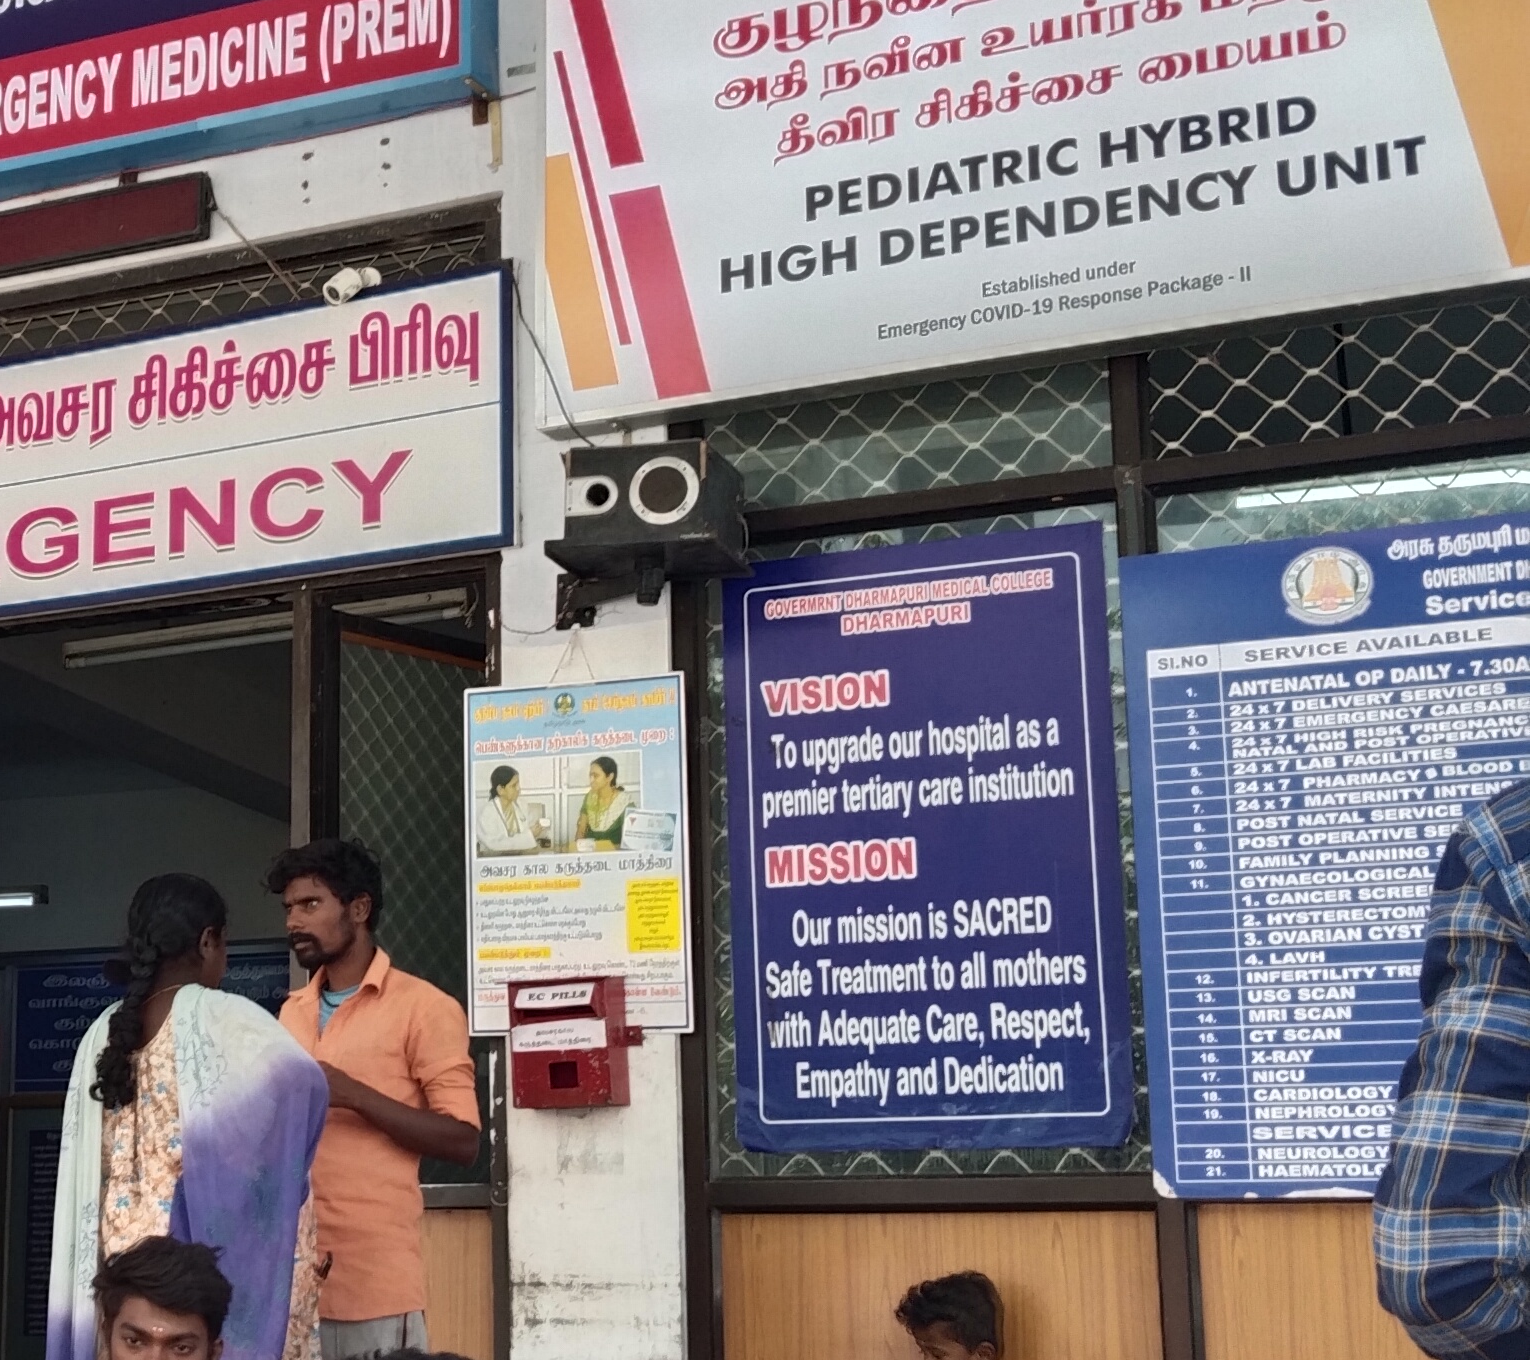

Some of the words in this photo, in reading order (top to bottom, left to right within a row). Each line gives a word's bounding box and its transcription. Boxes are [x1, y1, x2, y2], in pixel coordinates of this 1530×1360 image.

[131, 12, 306, 107] MEDICINE
[715, 59, 807, 109] அதி
[823, 35, 965, 96] நவீன
[774, 106, 899, 165] தீவிர
[915, 64, 1122, 127] சிகிச்சை
[1138, 12, 1345, 83] மையம்
[806, 137, 1077, 221] PEDIATRIC
[1099, 96, 1315, 168] HYBRID
[721, 236, 856, 292] HIGH
[879, 164, 1255, 265] DEPENDENCY
[1276, 135, 1425, 196] UNIT
[982, 267, 1079, 297] Established
[1085, 261, 1136, 280] under
[878, 314, 966, 339] Emergency
[970, 297, 1053, 324] COVID-19
[1058, 286, 1142, 311] Response
[1147, 273, 1223, 296] Package
[128, 339, 335, 424] சிகிச்சை
[349, 304, 478, 390] பிரிவு
[1423, 564, 1513, 589] GOVERNMENT
[841, 603, 971, 635] DHARMAPURI
[1245, 641, 1347, 663] SERVICE
[1356, 628, 1492, 652] AVAILABLE
[761, 670, 889, 716] VISION
[1228, 673, 1350, 697] ANTENATAL
[1356, 670, 1384, 686] OP
[1391, 663, 1452, 684] DAILY
[771, 734, 796, 767] To
[802, 726, 882, 772] upgrade
[889, 730, 921, 758] our
[928, 714, 1009, 761] hospital
[1016, 719, 1040, 748] as
[762, 780, 836, 827] premier
[842, 775, 911, 817] tertiary
[919, 777, 962, 806] care
[969, 761, 1073, 801] institution
[1237, 816, 1291, 830] POST
[1297, 811, 1365, 826] NATAL
[1372, 803, 1463, 821] SERVICE
[480, 864, 517, 877] அவசர
[523, 864, 548, 874] கால
[555, 858, 611, 873] கருத்தடை
[618, 857, 673, 871] மாத்திரை
[765, 838, 917, 887] MISSION
[792, 910, 831, 946] Our
[837, 905, 921, 942] mission
[928, 902, 947, 938] is
[953, 896, 1051, 937] SACRED
[550, 989, 587, 1000] PILLS
[766, 961, 811, 997] Safe
[817, 956, 926, 994] Treatment
[931, 956, 953, 989] to
[961, 951, 985, 988] all
[993, 948, 1085, 986] mothers
[1247, 989, 1292, 1002] USG
[1298, 986, 1356, 1000] SCAN
[767, 1011, 810, 1047] with
[818, 1009, 919, 1053] Adequate
[926, 1005, 983, 1046] Care,
[991, 1001, 1089, 1047] Respect,
[1249, 1008, 1288, 1022] MRI
[1294, 1006, 1352, 1021] SCAN
[1249, 1029, 1277, 1042] CT
[1283, 1027, 1342, 1041] SCAN
[796, 1059, 890, 1107] Empathy
[896, 1057, 937, 1096] and
[943, 1053, 1064, 1094] Dedication
[1251, 1049, 1314, 1064] X-RAY
[1252, 1070, 1305, 1083] NICU
